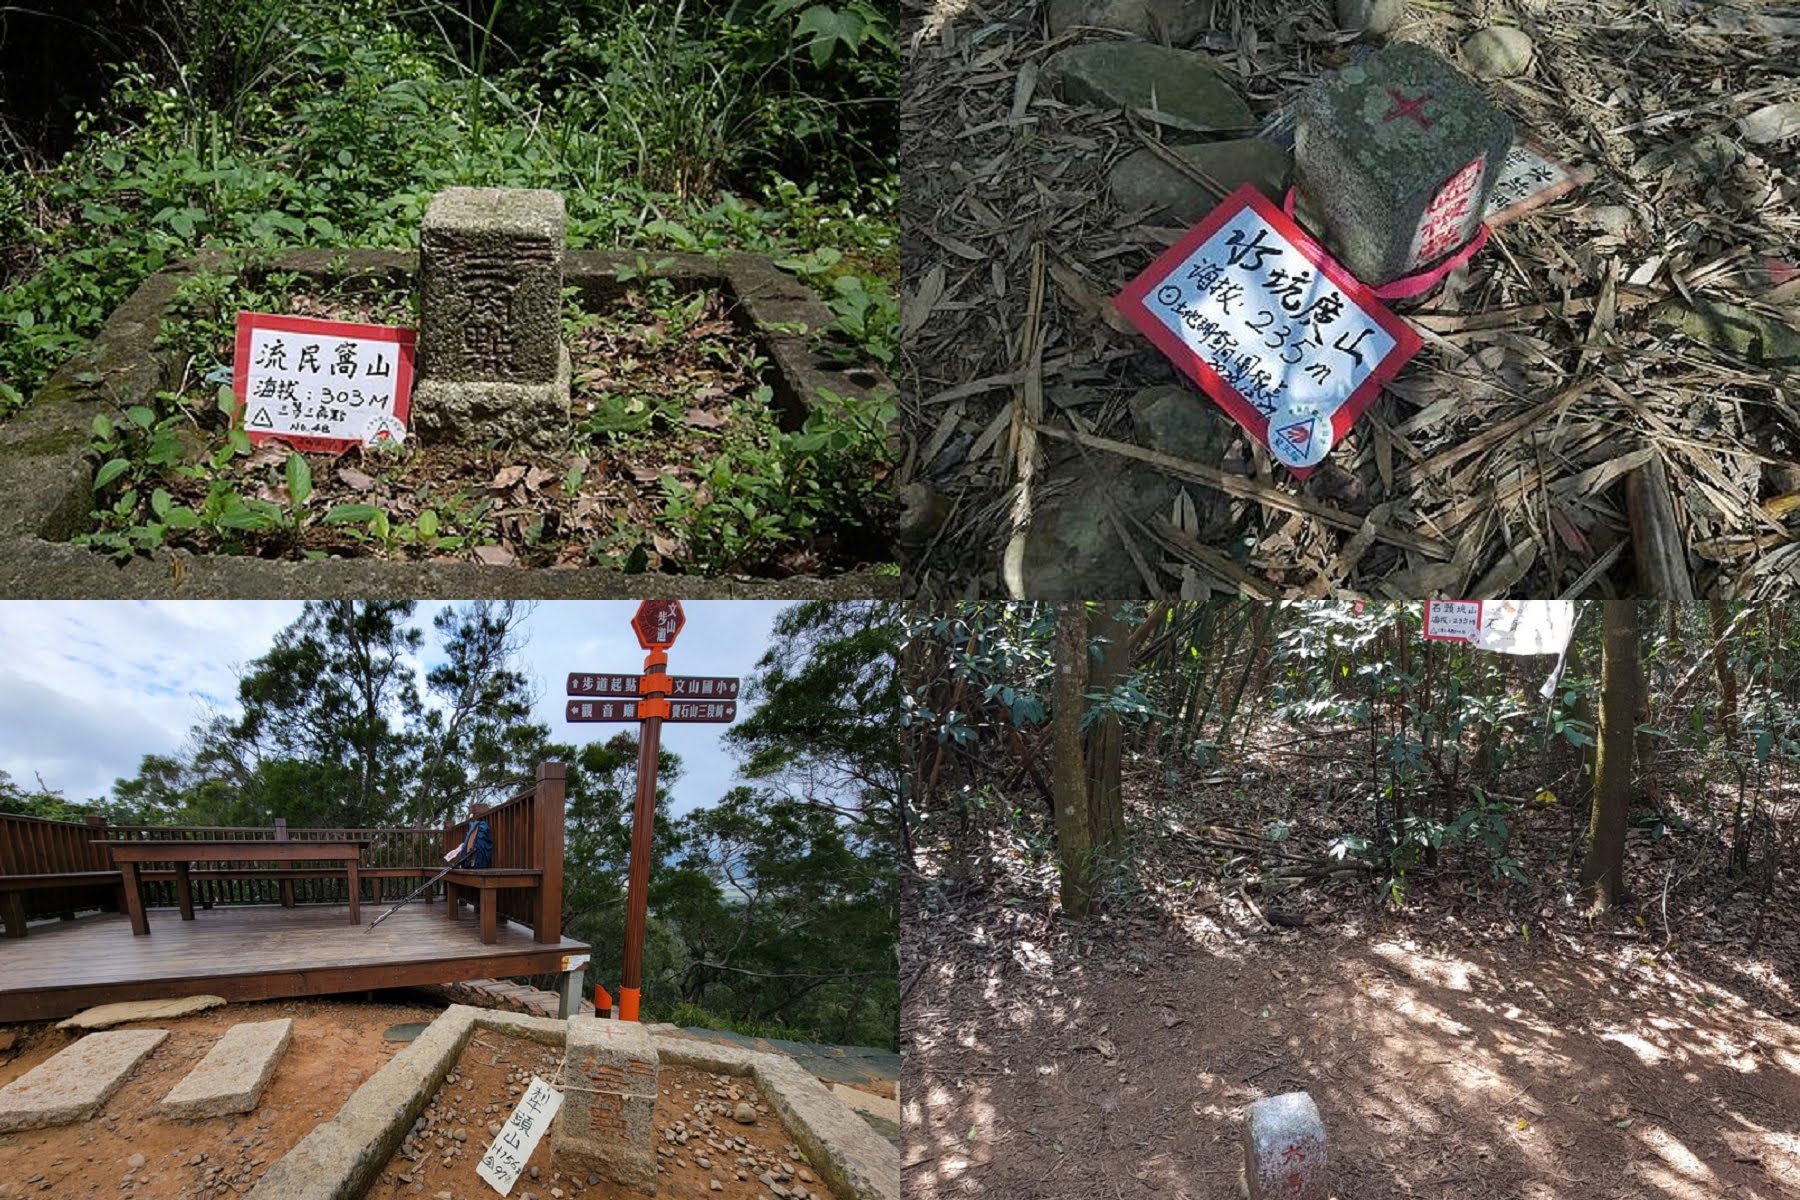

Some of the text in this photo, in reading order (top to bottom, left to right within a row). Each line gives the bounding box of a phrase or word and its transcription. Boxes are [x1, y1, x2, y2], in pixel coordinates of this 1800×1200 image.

[656, 611, 668, 642] 步道
[666, 602, 678, 634] 文山
[582, 676, 637, 692] 步道起點
[675, 679, 727, 695] 文山國小
[503, 1086, 551, 1150] 犁頭山
